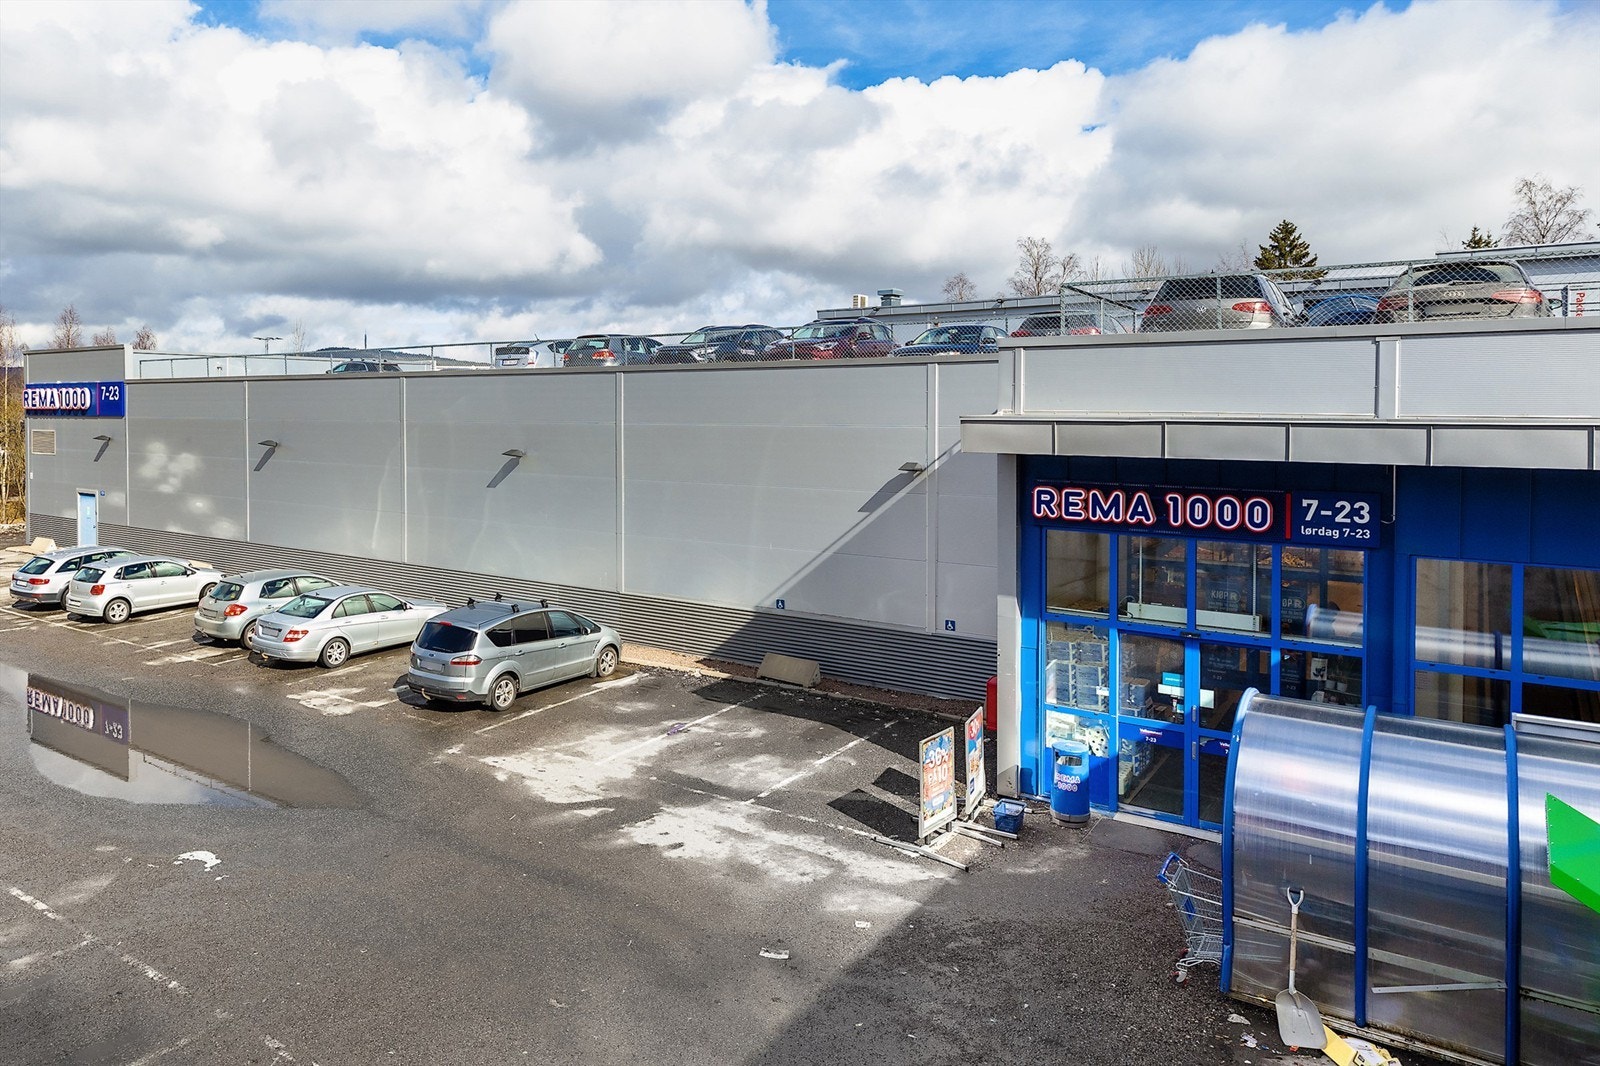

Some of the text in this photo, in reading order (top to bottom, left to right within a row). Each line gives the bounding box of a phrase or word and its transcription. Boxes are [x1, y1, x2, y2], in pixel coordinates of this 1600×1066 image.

[23, 388, 91, 410] REMA 1000
[101, 386, 120, 400] 7-23
[1033, 486, 1273, 532] REMA 1000
[1302, 499, 1370, 524] 7-23
[1301, 525, 1370, 539] lørdag 7-23
